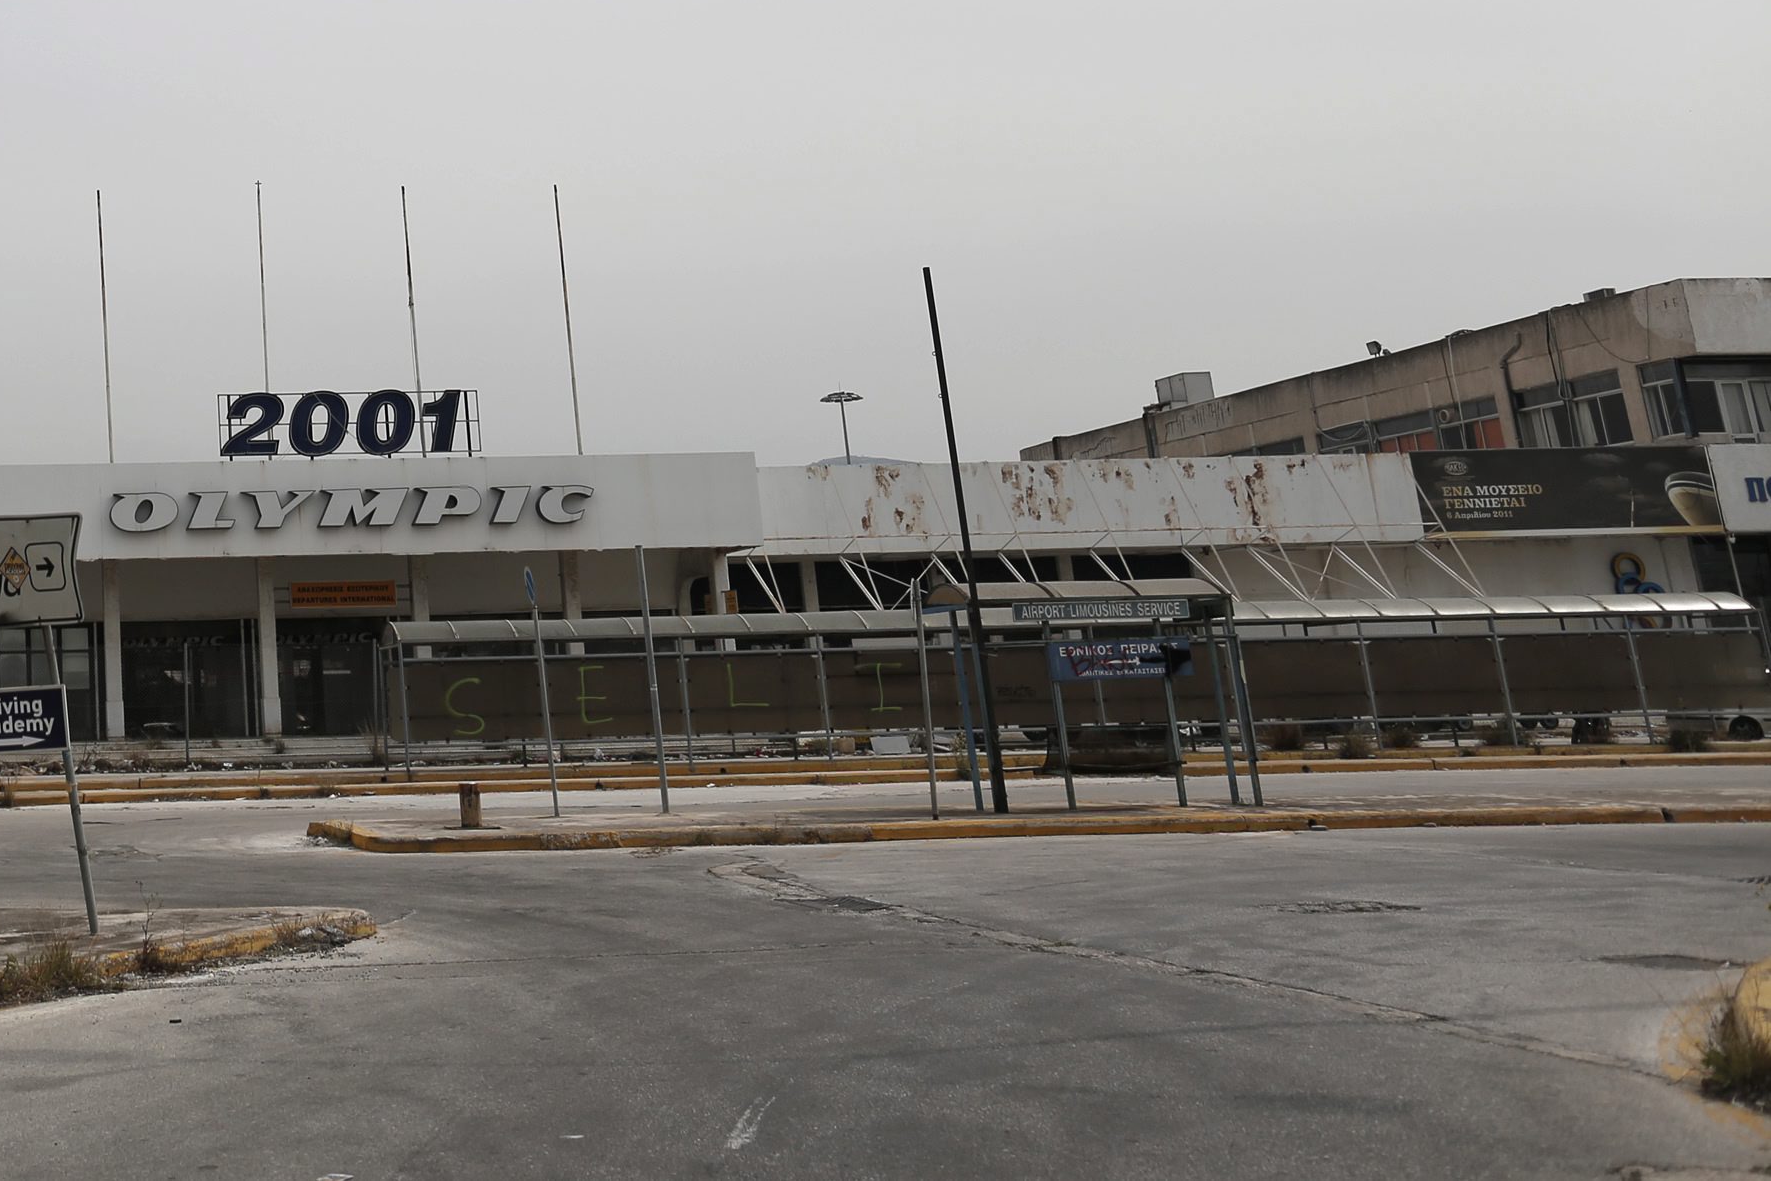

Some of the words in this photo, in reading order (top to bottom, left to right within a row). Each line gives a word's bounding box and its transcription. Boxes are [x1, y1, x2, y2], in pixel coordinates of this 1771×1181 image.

[220, 389, 462, 457] 2001
[1442, 486, 1474, 497] ΕΝΑ
[1475, 484, 1543, 496] ΜΟΥΣΕΙΟ
[109, 484, 595, 532] OLYMPIC
[1443, 497, 1526, 509] ΓΕΝΝΙΕΤΑΙ
[1492, 510, 1514, 518] 2011
[339, 595, 395, 603] INTERNATIONAL
[1021, 604, 1066, 619] AIRPORT
[1069, 603, 1132, 618] LIMOUSINES
[1137, 602, 1181, 616] SERVICE
